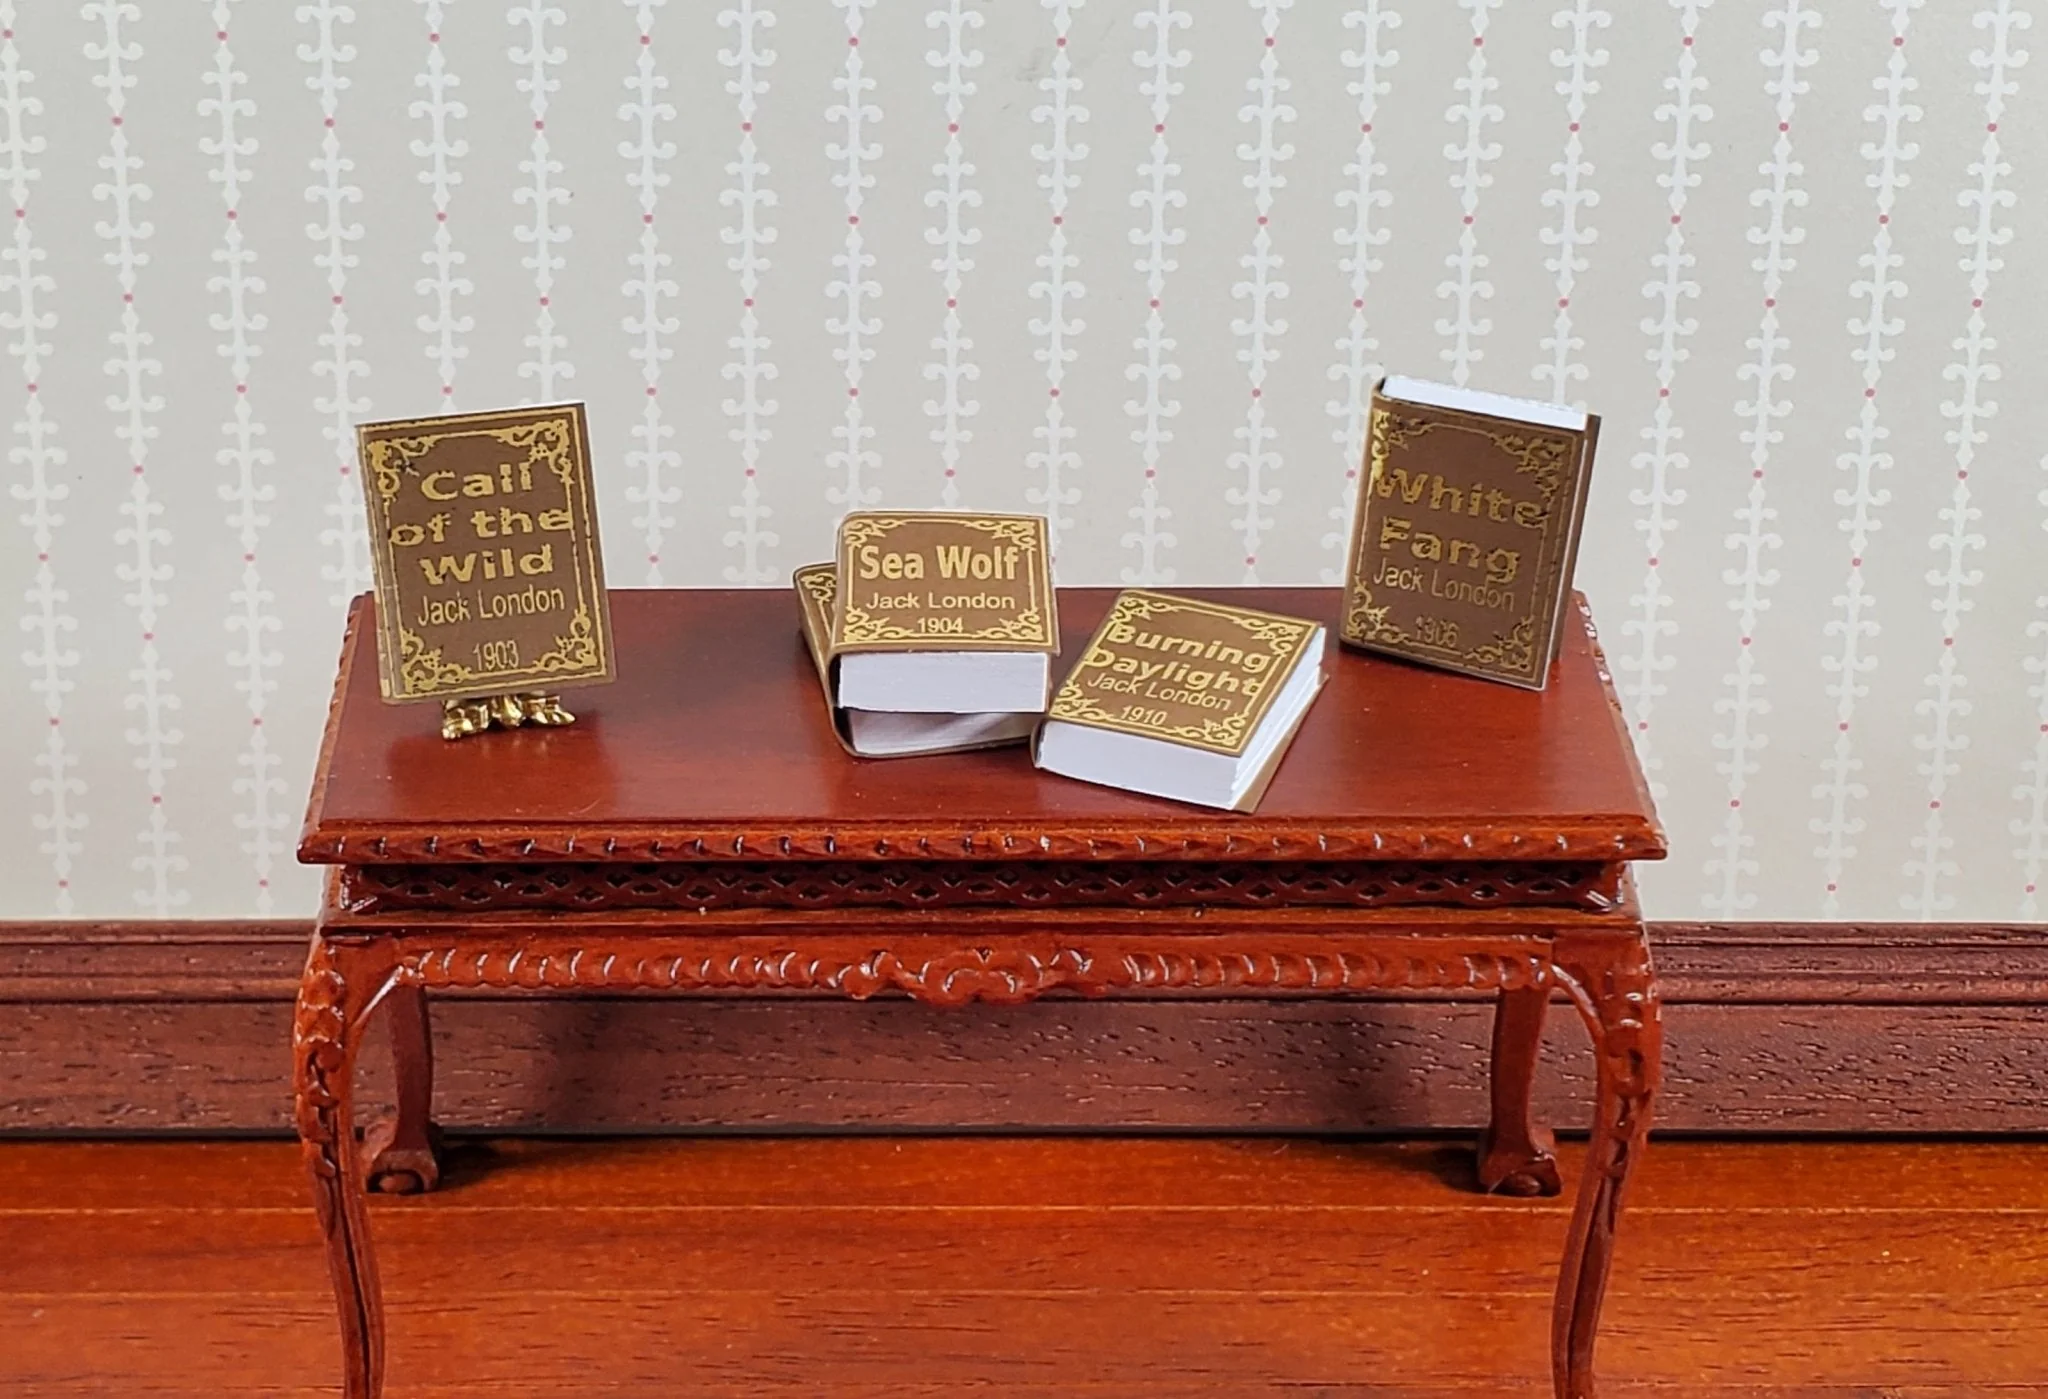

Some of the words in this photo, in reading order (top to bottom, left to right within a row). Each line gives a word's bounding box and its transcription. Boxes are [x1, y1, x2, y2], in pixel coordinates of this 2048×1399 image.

[421, 462, 533, 500] Call
[1375, 468, 1547, 528] White
[389, 513, 451, 545] of
[471, 507, 572, 538] the
[419, 543, 553, 585] Wild
[859, 545, 924, 580] Sea
[936, 545, 1019, 580] Wolf
[1379, 515, 1521, 584] Fang
[866, 592, 920, 610] Jack
[928, 592, 1015, 610] London
[1373, 557, 1424, 593] Jack
[1432, 569, 1515, 612] London
[418, 591, 471, 626] Jack
[479, 584, 565, 620] London
[918, 617, 964, 634] 1904
[473, 640, 520, 671] 1903
[1106, 624, 1271, 673] Burning
[1083, 647, 1263, 696] Daylight
[1088, 672, 1138, 695] Jack
[1145, 681, 1231, 711] London
[1119, 705, 1168, 726] 1910
